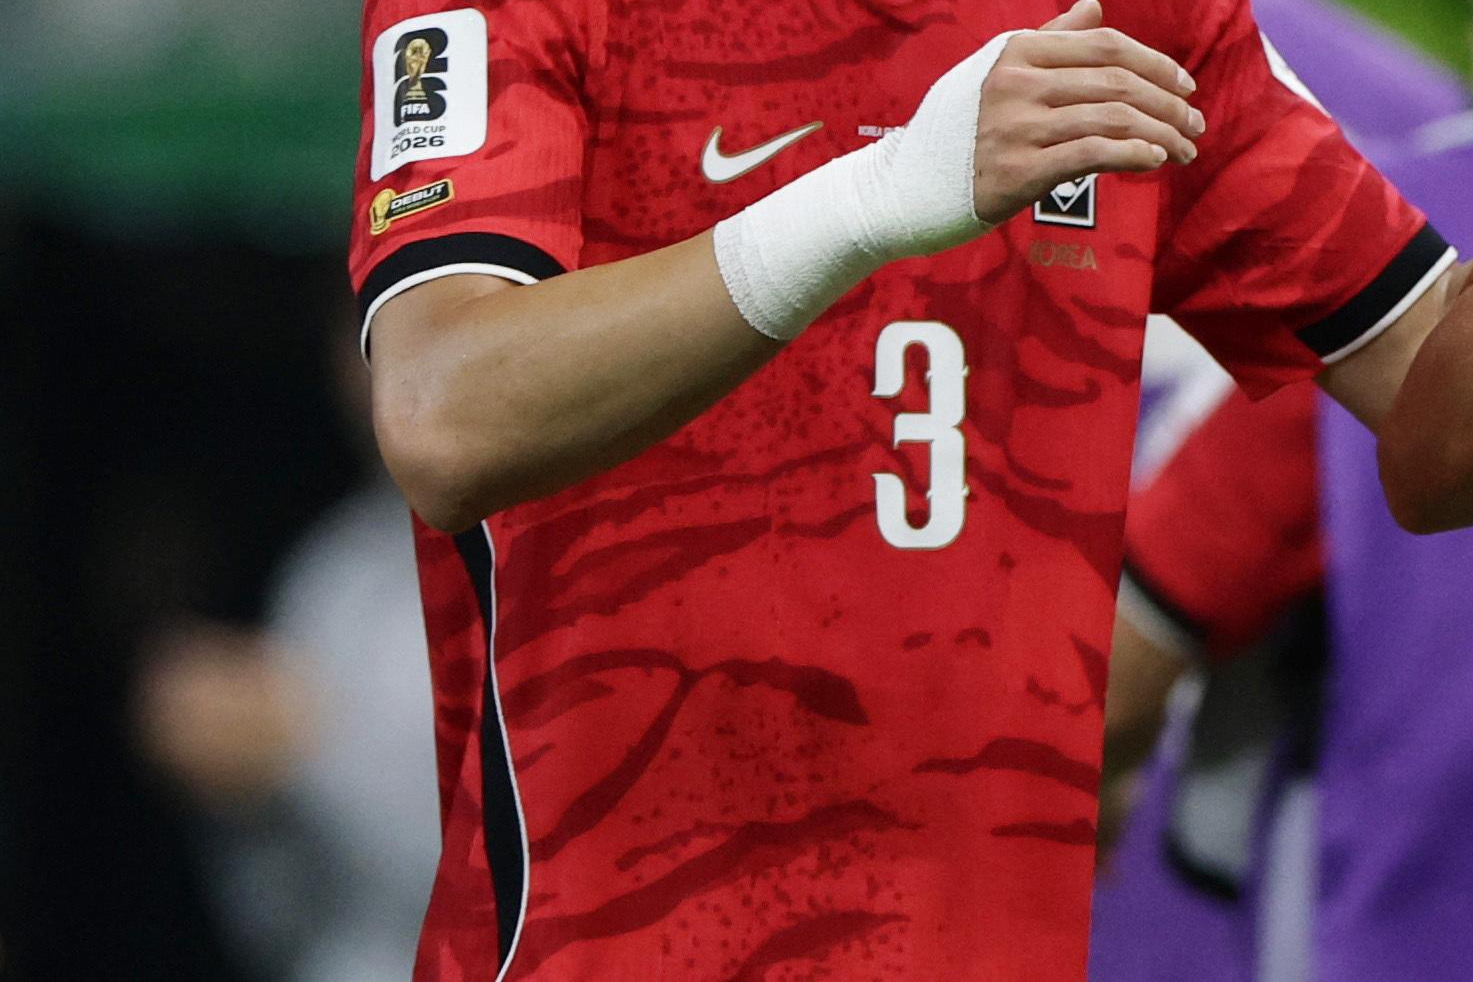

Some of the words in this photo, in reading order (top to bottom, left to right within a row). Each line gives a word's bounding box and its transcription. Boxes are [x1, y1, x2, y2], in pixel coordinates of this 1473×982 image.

[400, 103, 430, 118] FIFA
[423, 124, 447, 134] CUP
[390, 135, 445, 159] 2026
[390, 183, 446, 210] DEBUT
[1030, 240, 1097, 270] KOREA
[871, 320, 970, 550] 3
